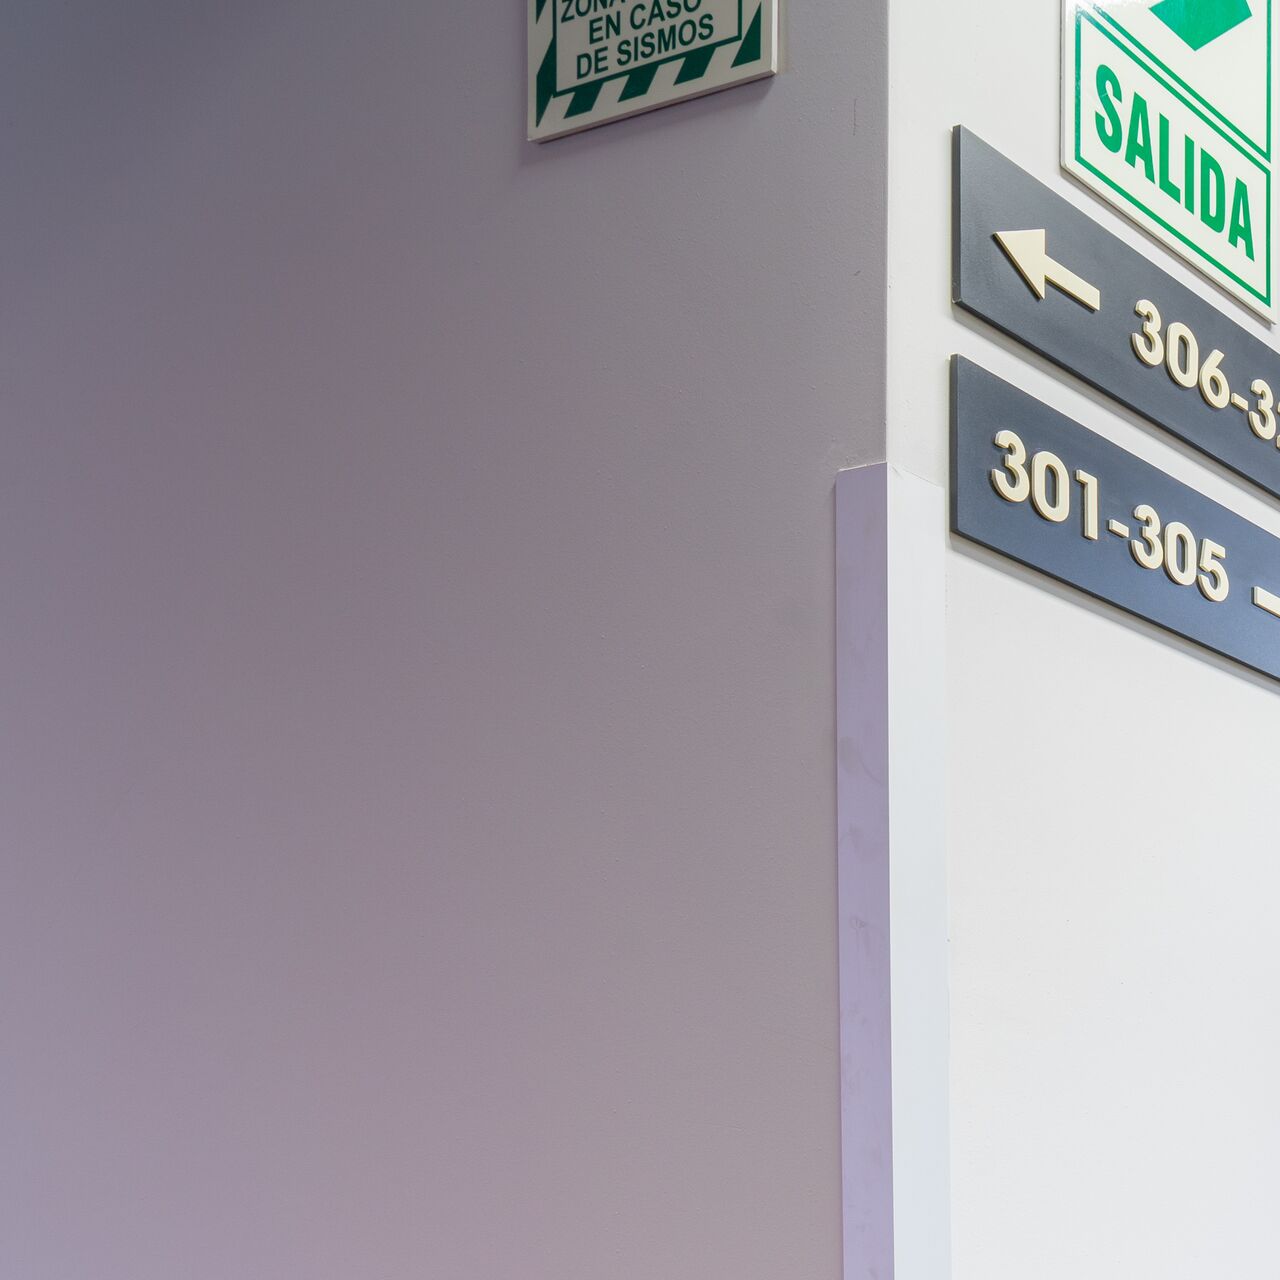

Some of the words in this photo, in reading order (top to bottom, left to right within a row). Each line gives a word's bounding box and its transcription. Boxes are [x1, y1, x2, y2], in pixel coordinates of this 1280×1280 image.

[561, 0, 624, 23] ZO
[589, 10, 620, 45] EN
[576, 46, 609, 80] DE
[617, 13, 714, 66] SISMOS
[1094, 64, 1255, 262] SALIDA
[990, 429, 1229, 602] 301-305
